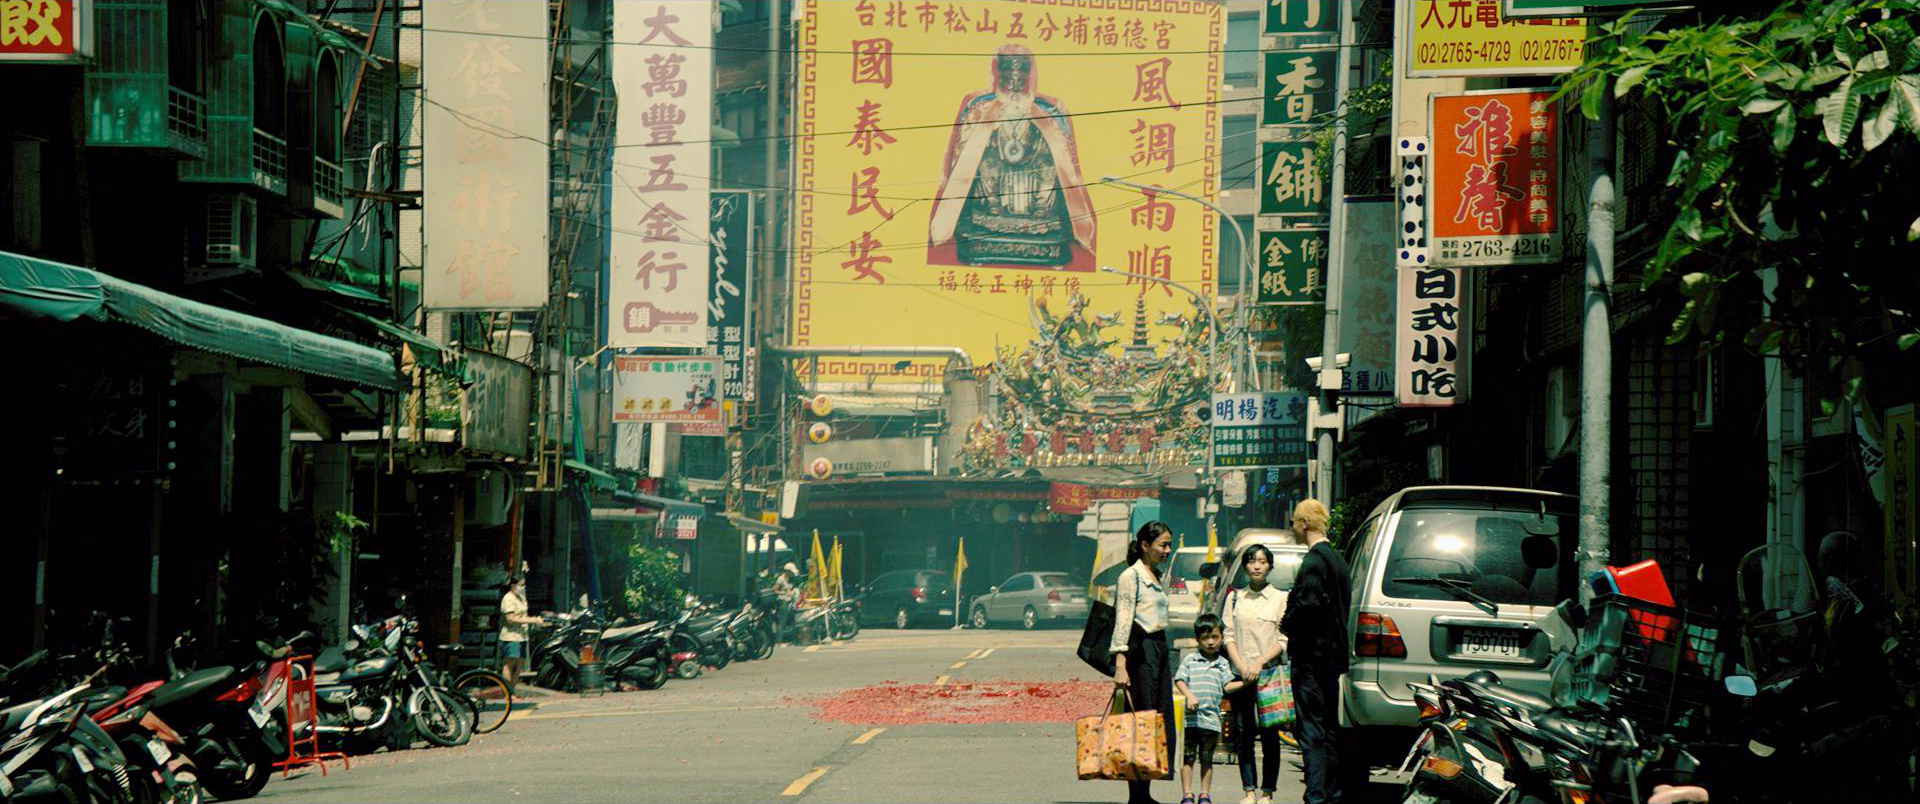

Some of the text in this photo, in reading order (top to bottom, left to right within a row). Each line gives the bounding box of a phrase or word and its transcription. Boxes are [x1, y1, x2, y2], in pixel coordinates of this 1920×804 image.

[854, 0, 1177, 50] 台北市松山五分埔福德宮
[1417, 41, 1511, 64] (02)2765-4729
[635, 5, 694, 293] 大萬豐五金行
[841, 38, 898, 284] 國泰民安
[1125, 56, 1181, 298] 風調雨順
[1463, 237, 1551, 258] 2763-4216
[628, 307, 650, 328] 鎖
[1410, 268, 1461, 398] 日式小吃
[1342, 370, 1394, 391] 各種小
